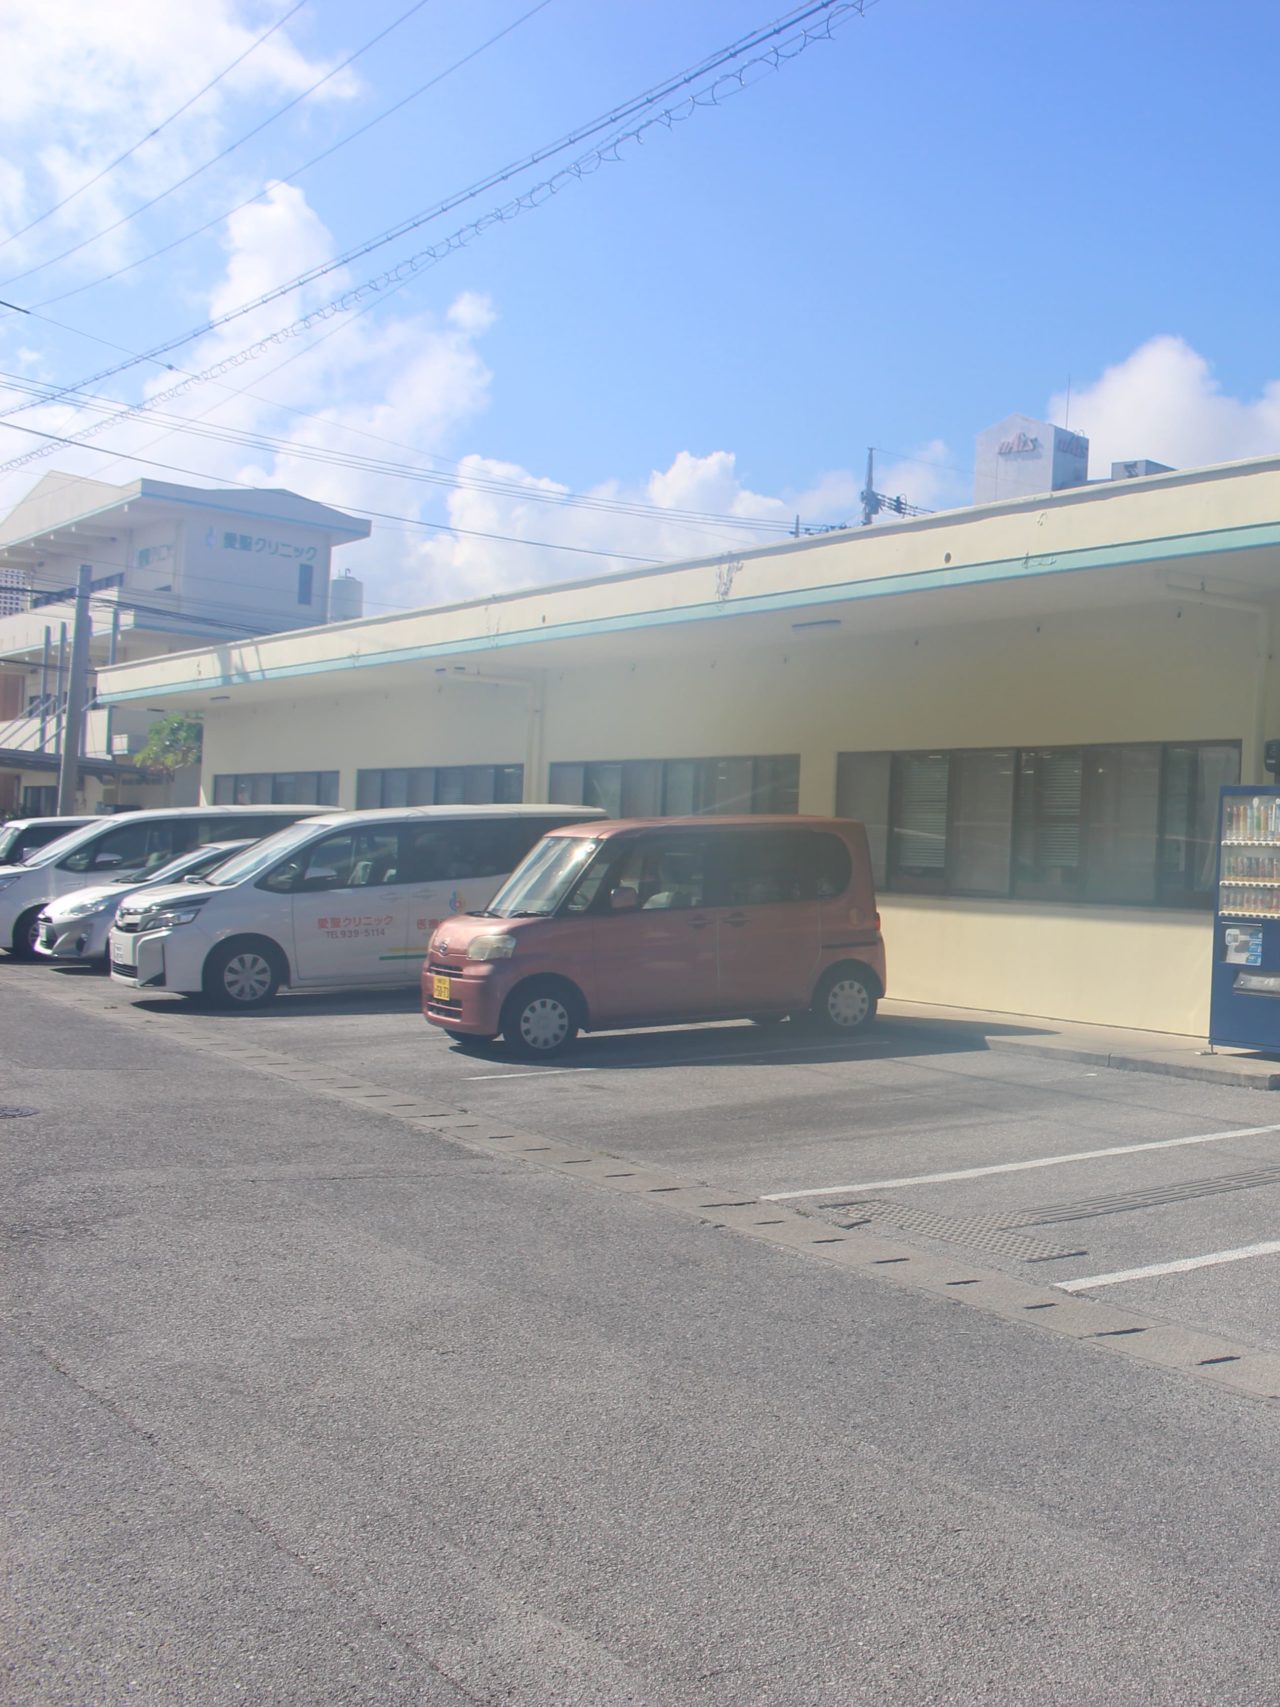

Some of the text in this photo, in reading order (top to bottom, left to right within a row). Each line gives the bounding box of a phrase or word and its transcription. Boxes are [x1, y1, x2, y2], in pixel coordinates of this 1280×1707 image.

[318, 915, 393, 929] 愛聖クリニック
